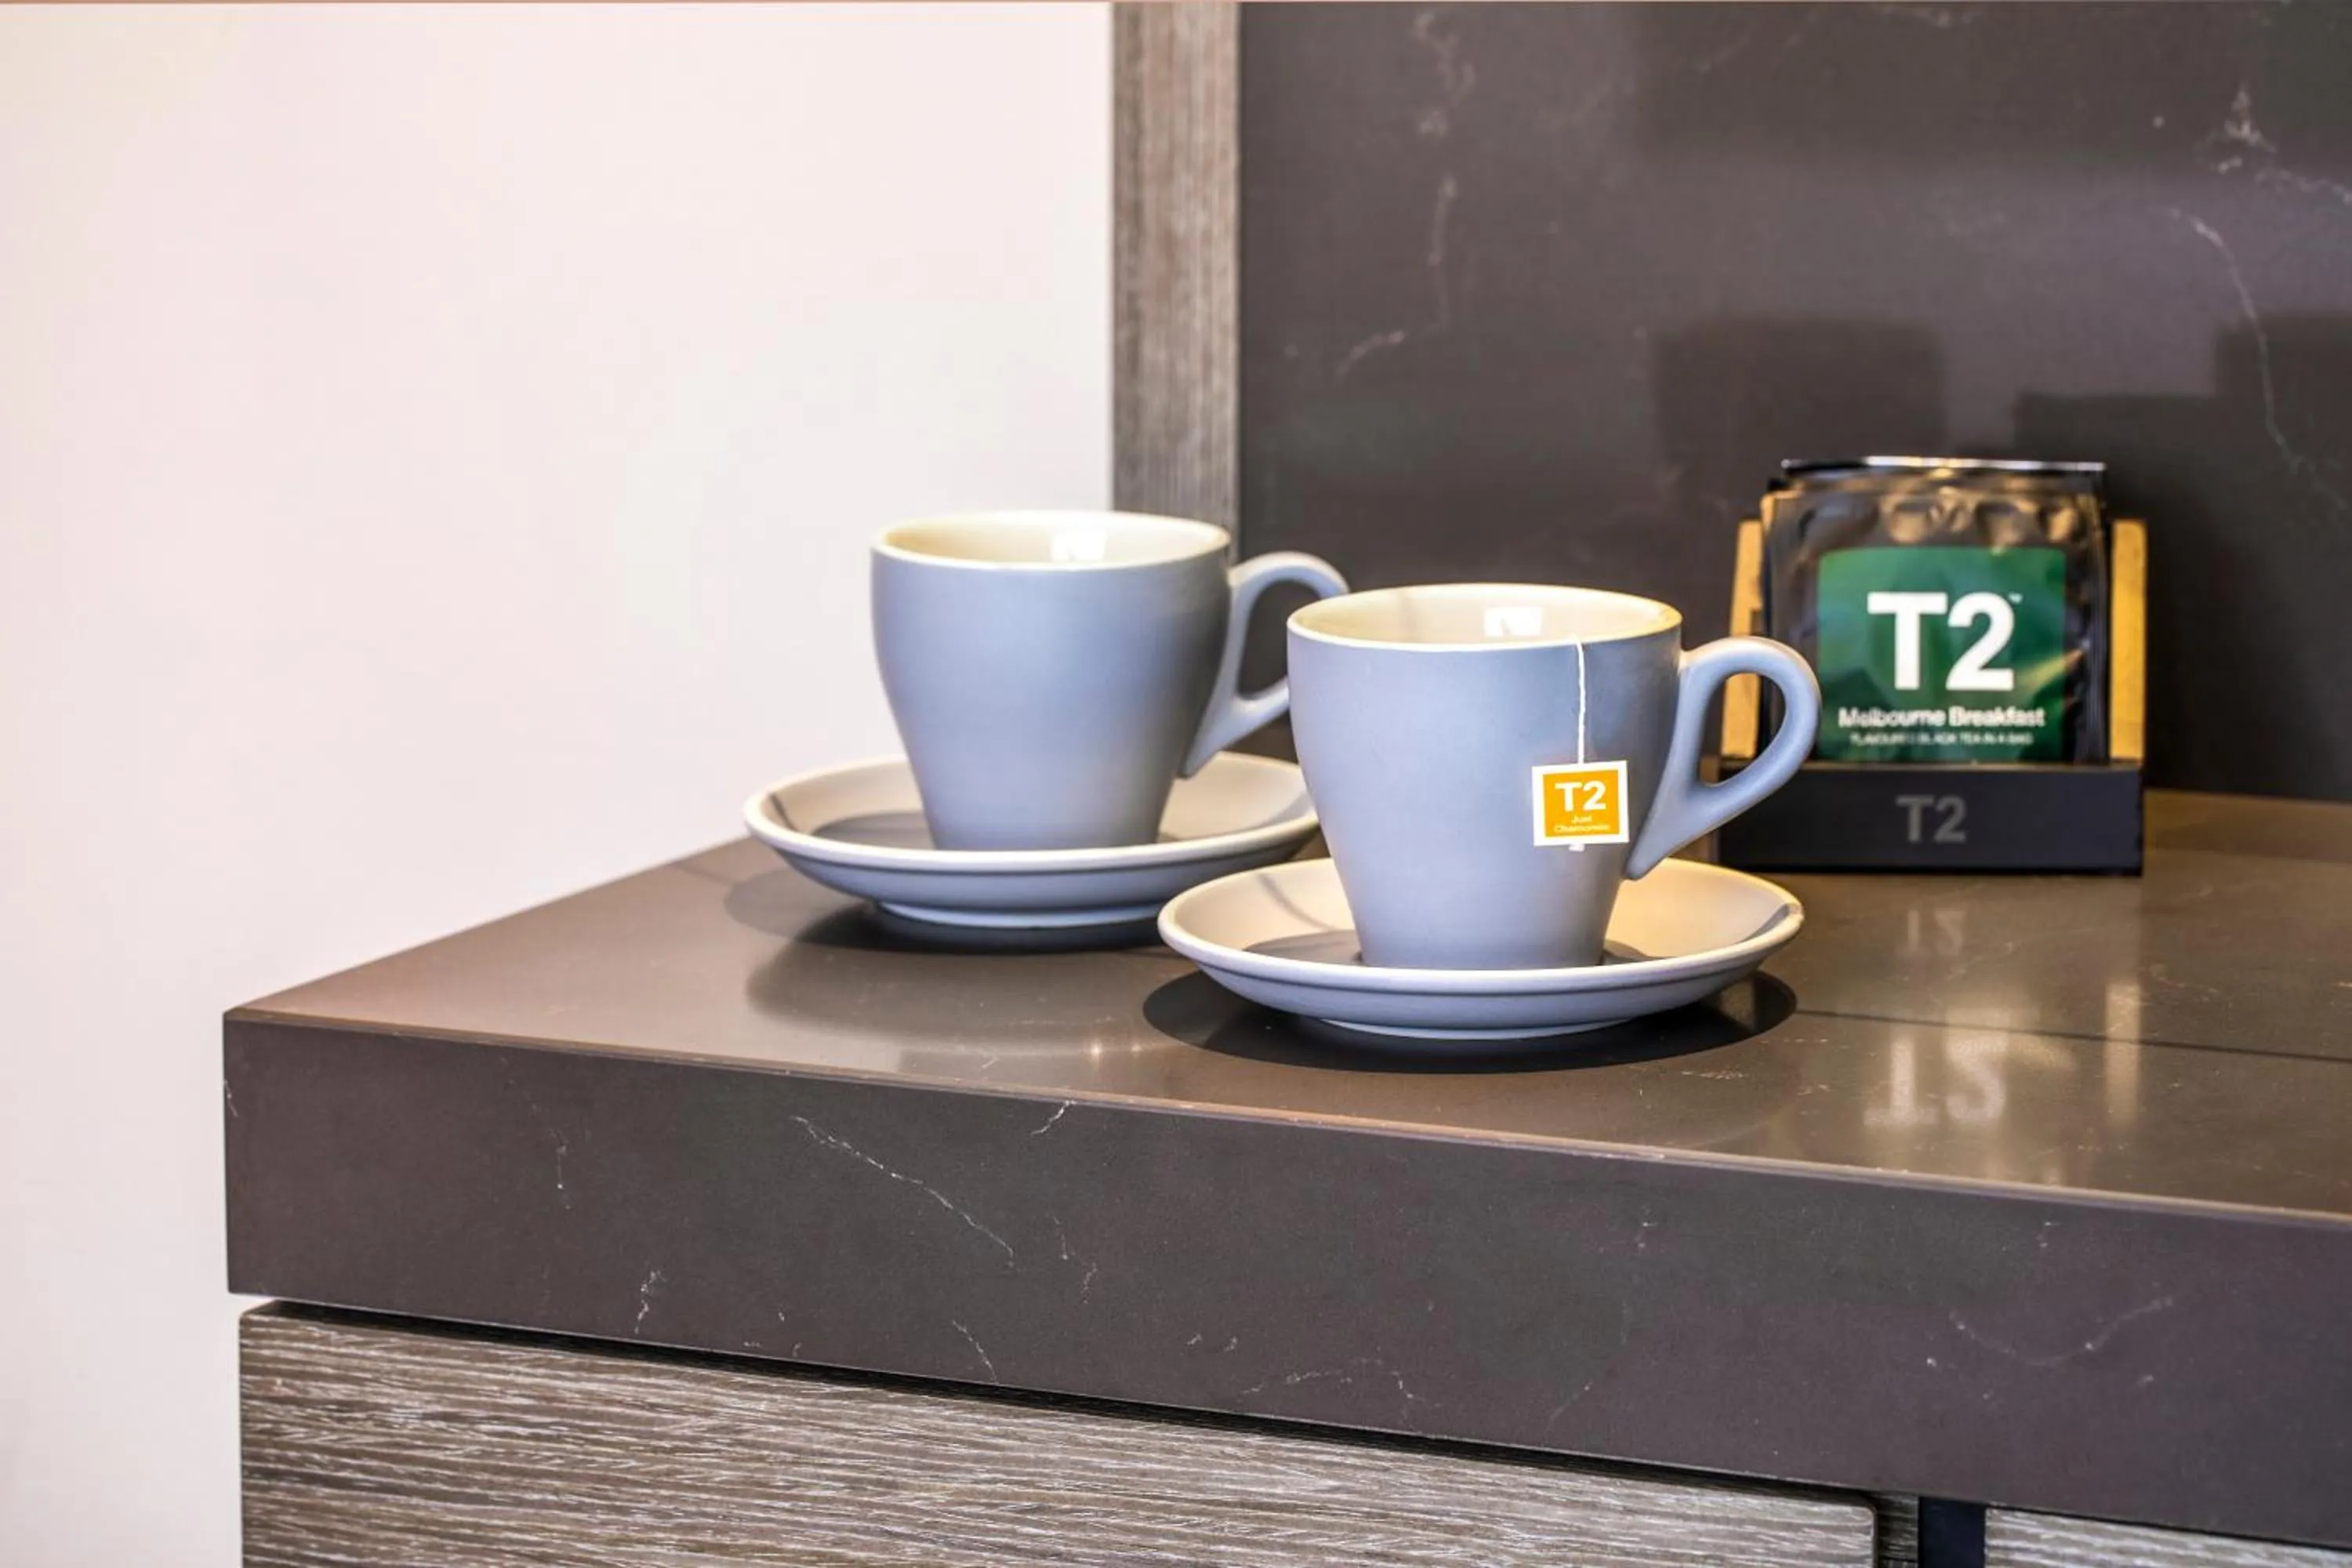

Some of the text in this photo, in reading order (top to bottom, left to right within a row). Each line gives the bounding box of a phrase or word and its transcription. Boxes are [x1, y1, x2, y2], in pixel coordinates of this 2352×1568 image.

[1867, 592, 2015, 690] T2
[1838, 706, 2045, 727] Melbourne Breakfast
[1555, 780, 1606, 811] T2
[1896, 794, 1966, 844] T2
